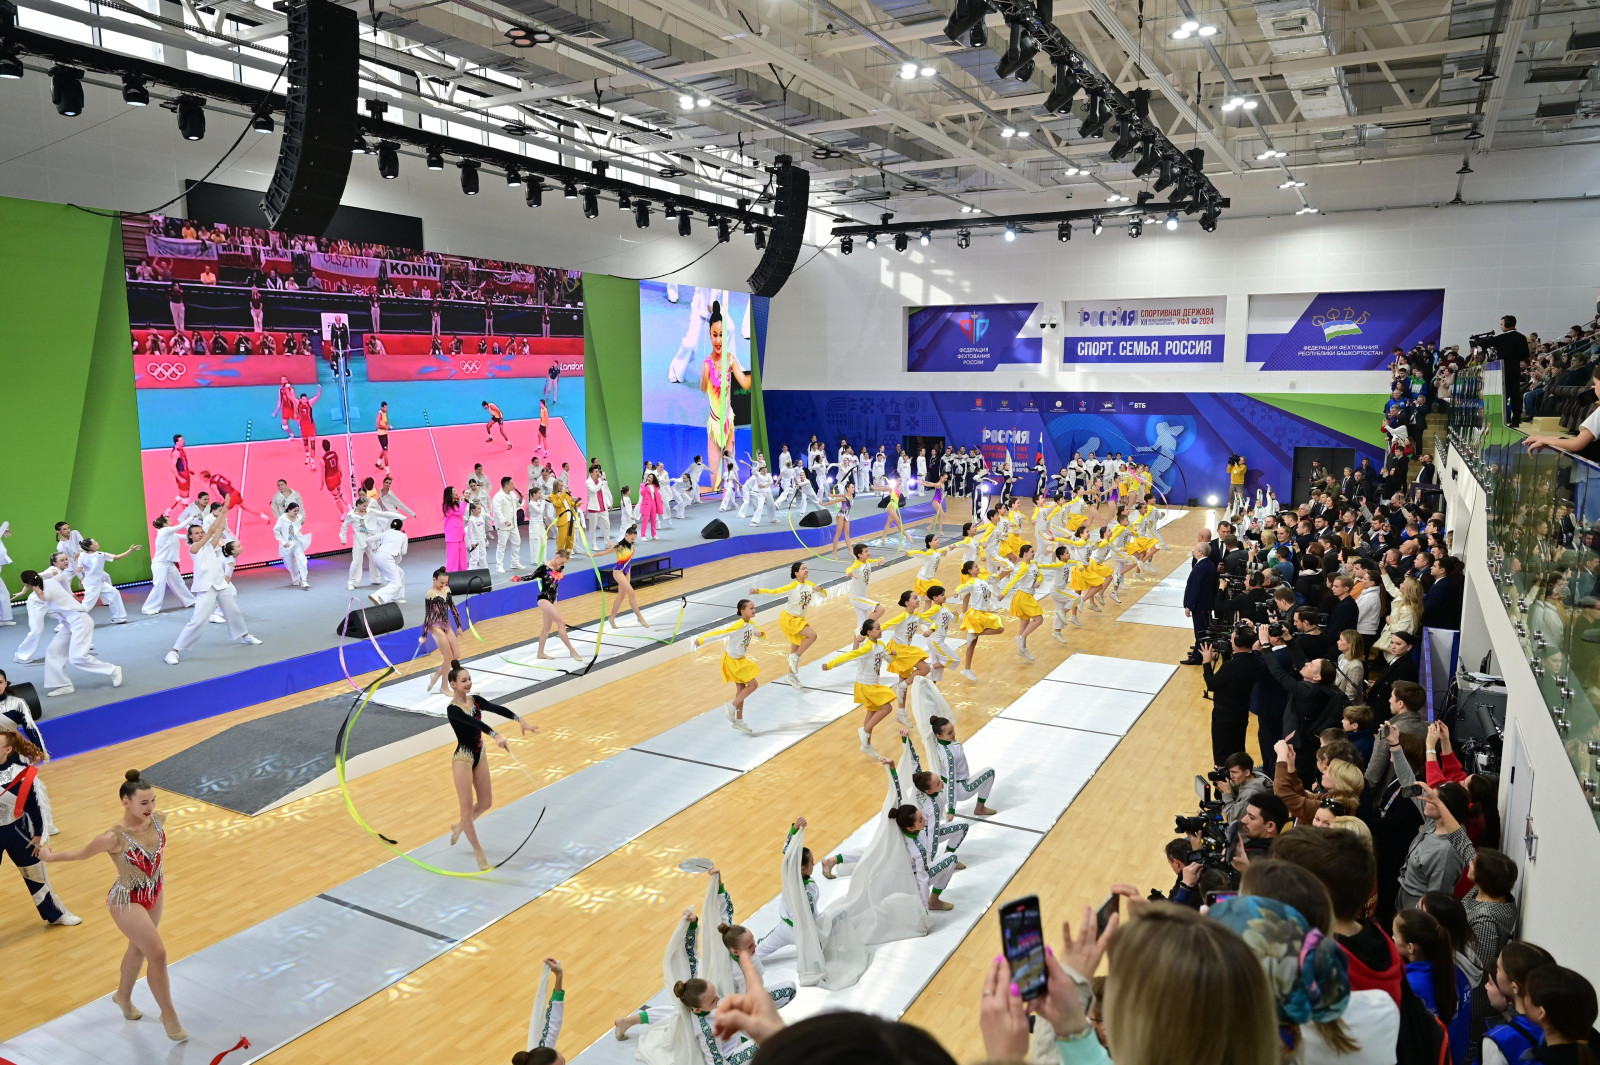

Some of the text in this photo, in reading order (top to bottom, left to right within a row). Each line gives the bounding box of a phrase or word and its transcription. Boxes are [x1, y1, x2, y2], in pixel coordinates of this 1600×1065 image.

[390, 262, 437, 277] KONIN
[1079, 308, 1139, 327] РОССИЯ
[1140, 307, 1215, 318] СПОРТИВНАЯ ДЕРЖАВА
[1176, 317, 1190, 325] УФА
[1199, 317, 1214, 325] 2024
[1077, 340, 1212, 356] СПОРТ. СЕМЬЯ. РОССИЯ
[560, 361, 584, 371] London
[982, 429, 1030, 444] РОССИЯ
